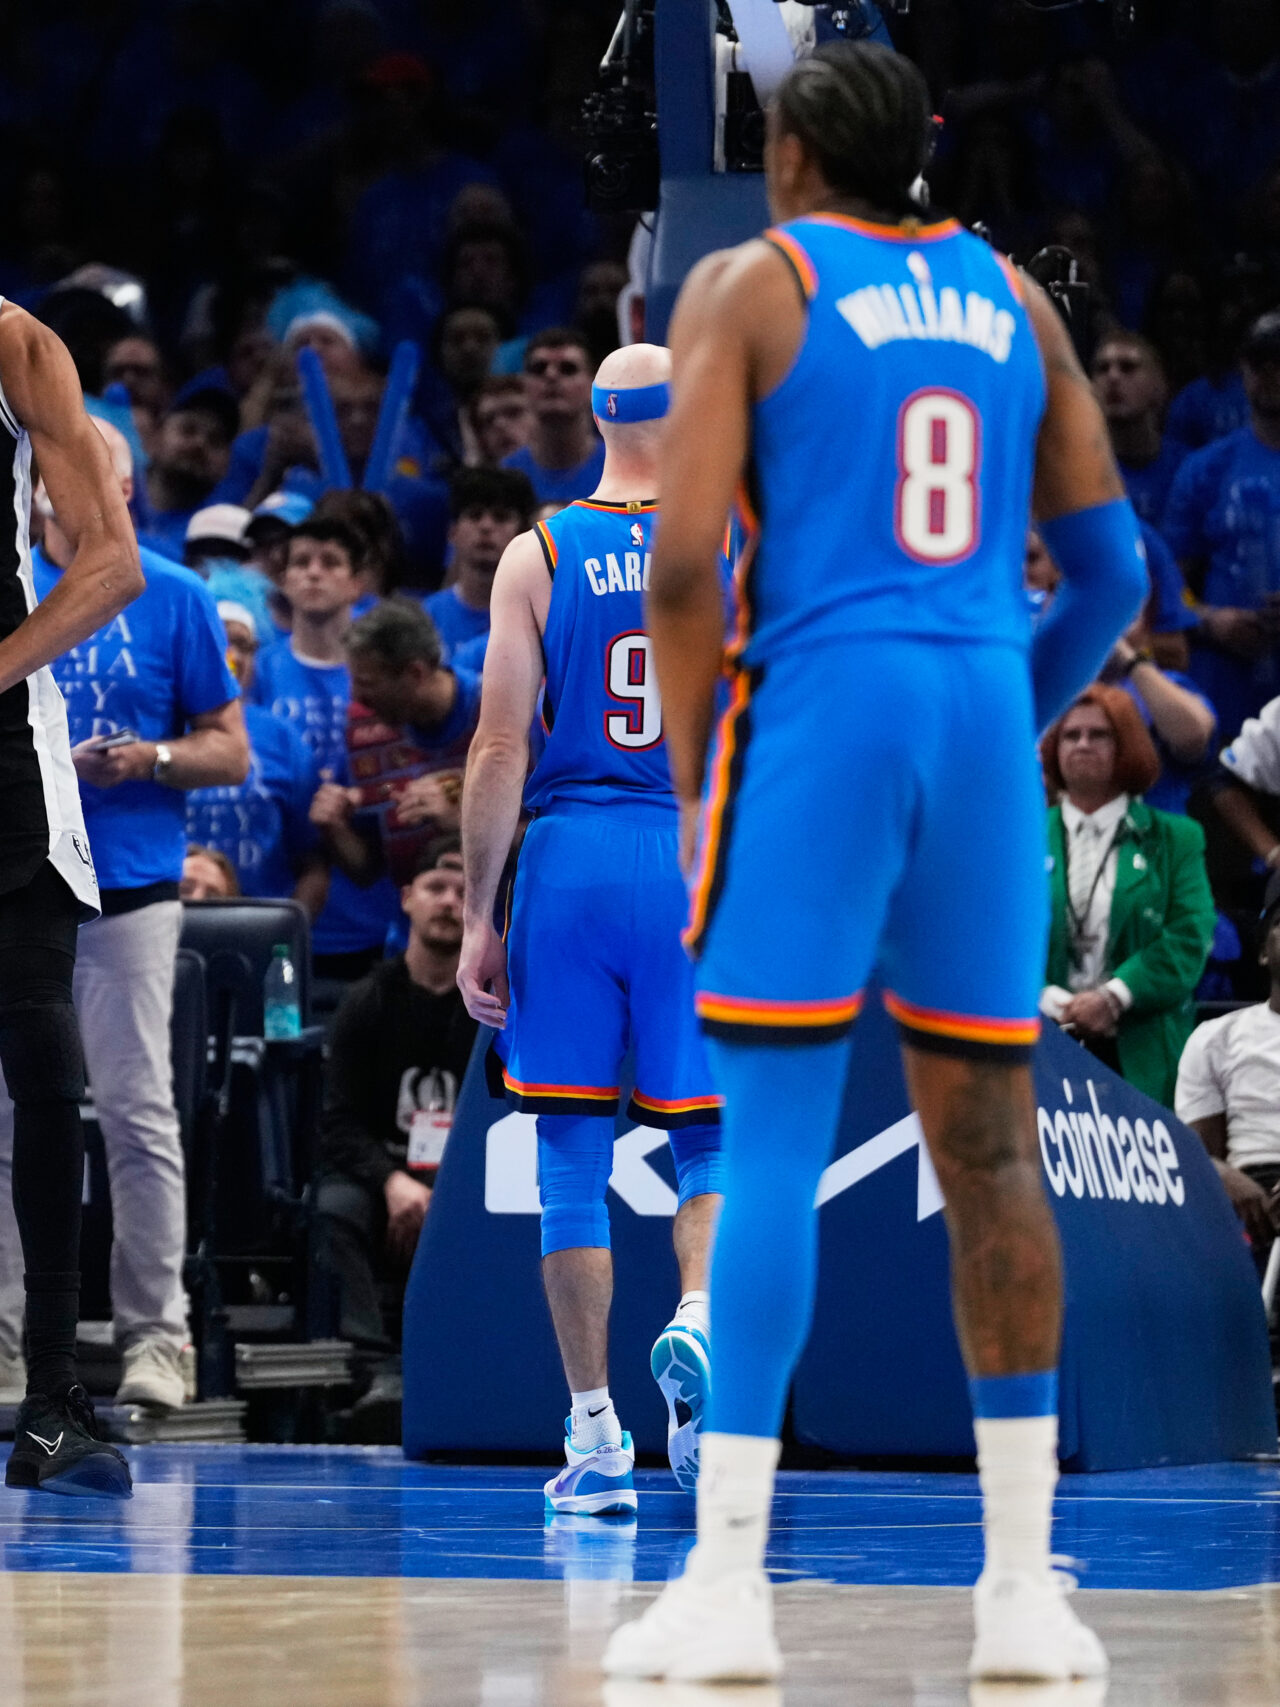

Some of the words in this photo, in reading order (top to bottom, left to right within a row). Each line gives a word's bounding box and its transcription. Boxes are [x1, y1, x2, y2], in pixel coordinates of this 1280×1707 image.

[835, 283, 1016, 364] WILLIAMS
[893, 385, 983, 566] 8
[604, 629, 666, 752] 9
[1037, 1078, 1186, 1207] coinbase
